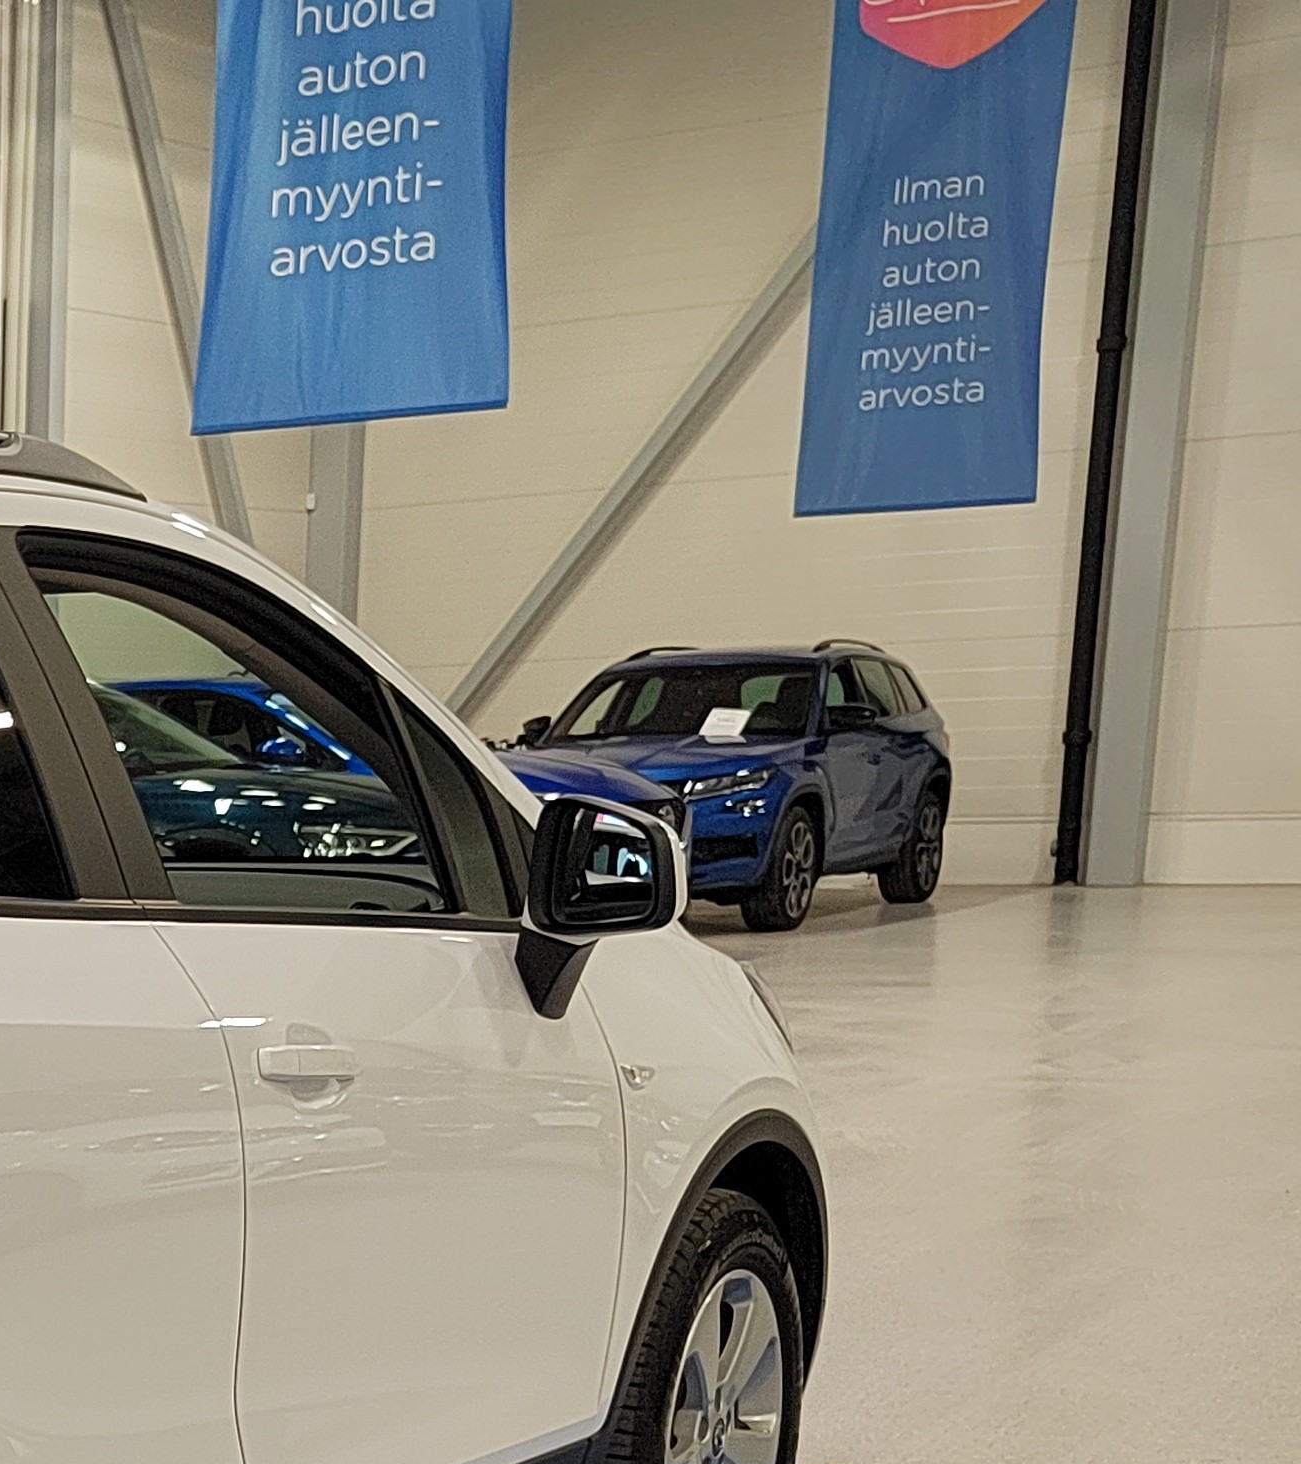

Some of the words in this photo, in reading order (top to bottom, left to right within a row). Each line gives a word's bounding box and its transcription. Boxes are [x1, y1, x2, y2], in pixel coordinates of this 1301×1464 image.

[296, 0, 436, 37] huolta
[298, 51, 426, 96] auton
[276, 111, 440, 166] jälleen-
[271, 162, 443, 222] myynti-
[894, 174, 985, 205] Ilman
[883, 211, 989, 247] huolta
[270, 226, 436, 276] arvosta
[882, 255, 981, 288] auton
[865, 298, 990, 336] jälleen-
[860, 333, 991, 373] myynti-
[858, 378, 985, 412] arvosta
